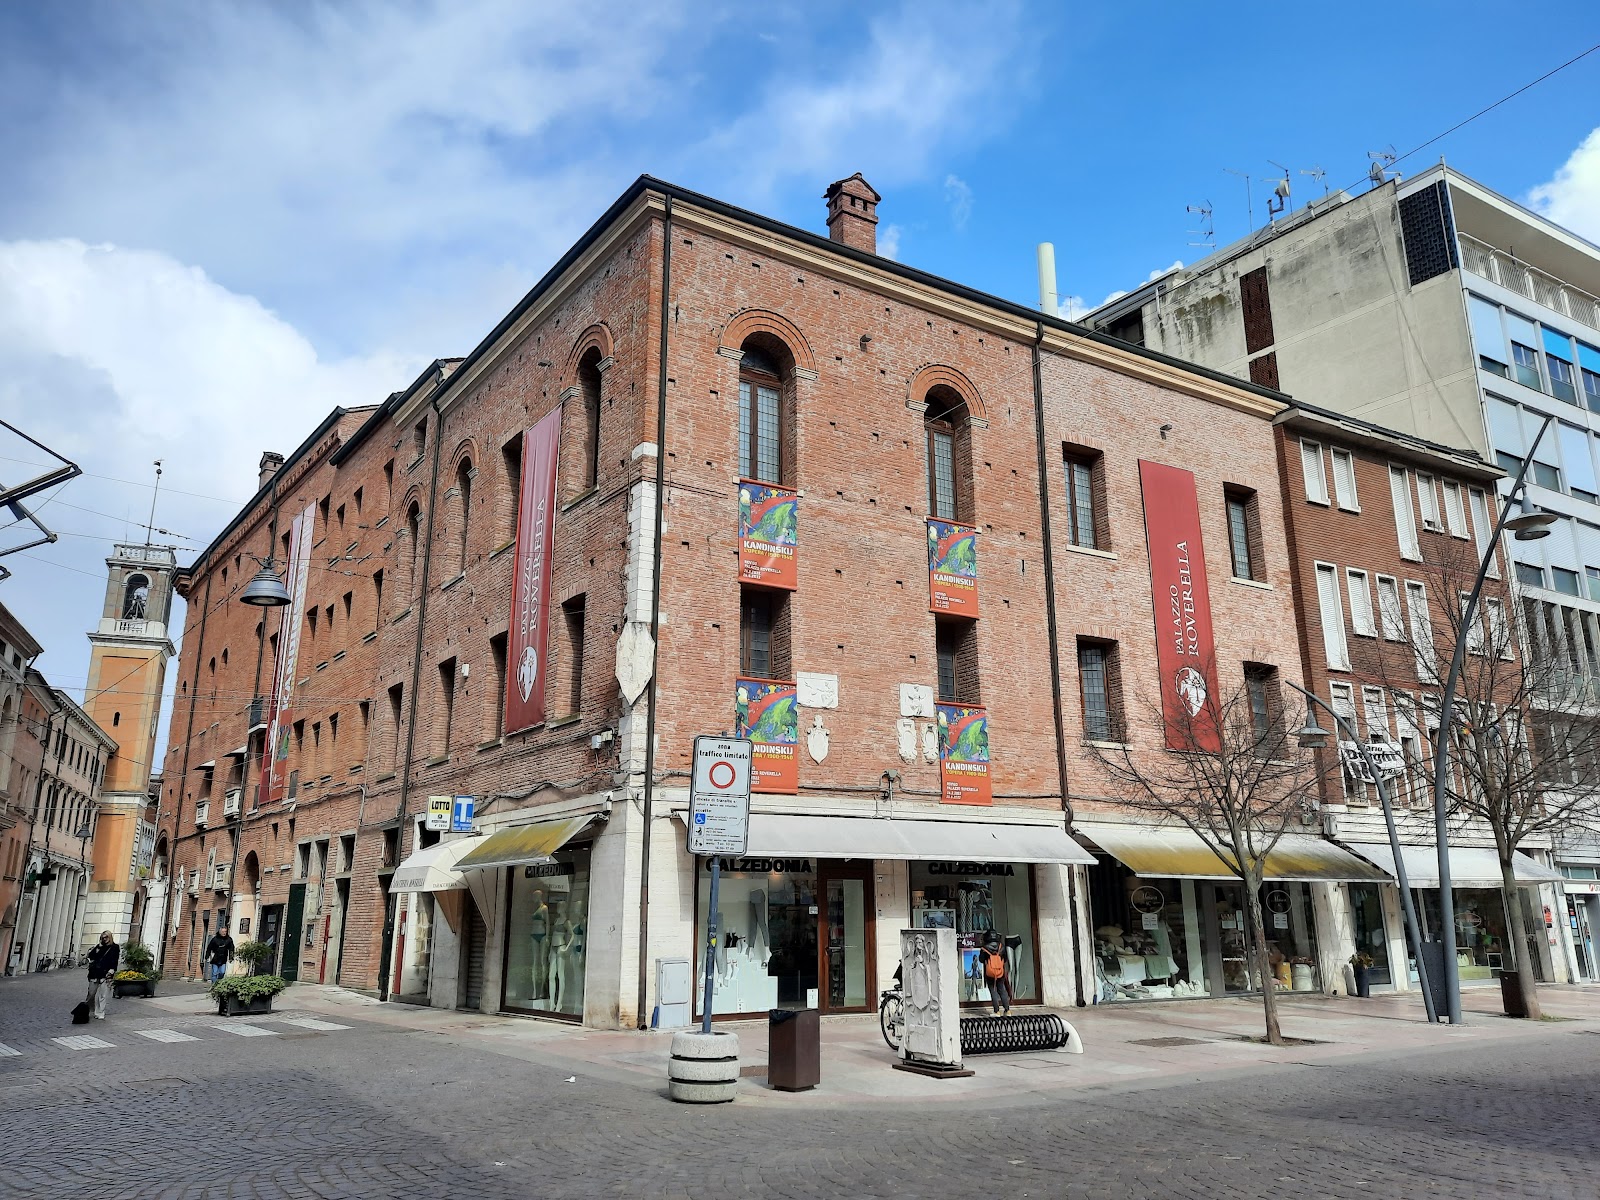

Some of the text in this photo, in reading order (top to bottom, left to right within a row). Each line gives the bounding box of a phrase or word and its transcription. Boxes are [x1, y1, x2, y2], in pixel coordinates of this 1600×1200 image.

[744, 541, 793, 555] KANDINSKIJ
[529, 497, 545, 632] ROVERELLA
[934, 574, 974, 586] KANDINSKIJ
[521, 557, 531, 636] PALAZZO
[1176, 540, 1199, 657] ROVERELLA
[1169, 584, 1185, 655] PALAZZO
[281, 561, 304, 710] KANDINSKIJ
[699, 750, 722, 758] traffico
[724, 752, 748, 760] limitato
[753, 744, 794, 754] NDINSKIJ
[946, 762, 987, 772] KANDINSKIJ
[431, 800, 450, 811] LOTTO
[706, 858, 812, 873] CALZEDONIA
[928, 862, 1014, 876] CALZEDONIA
